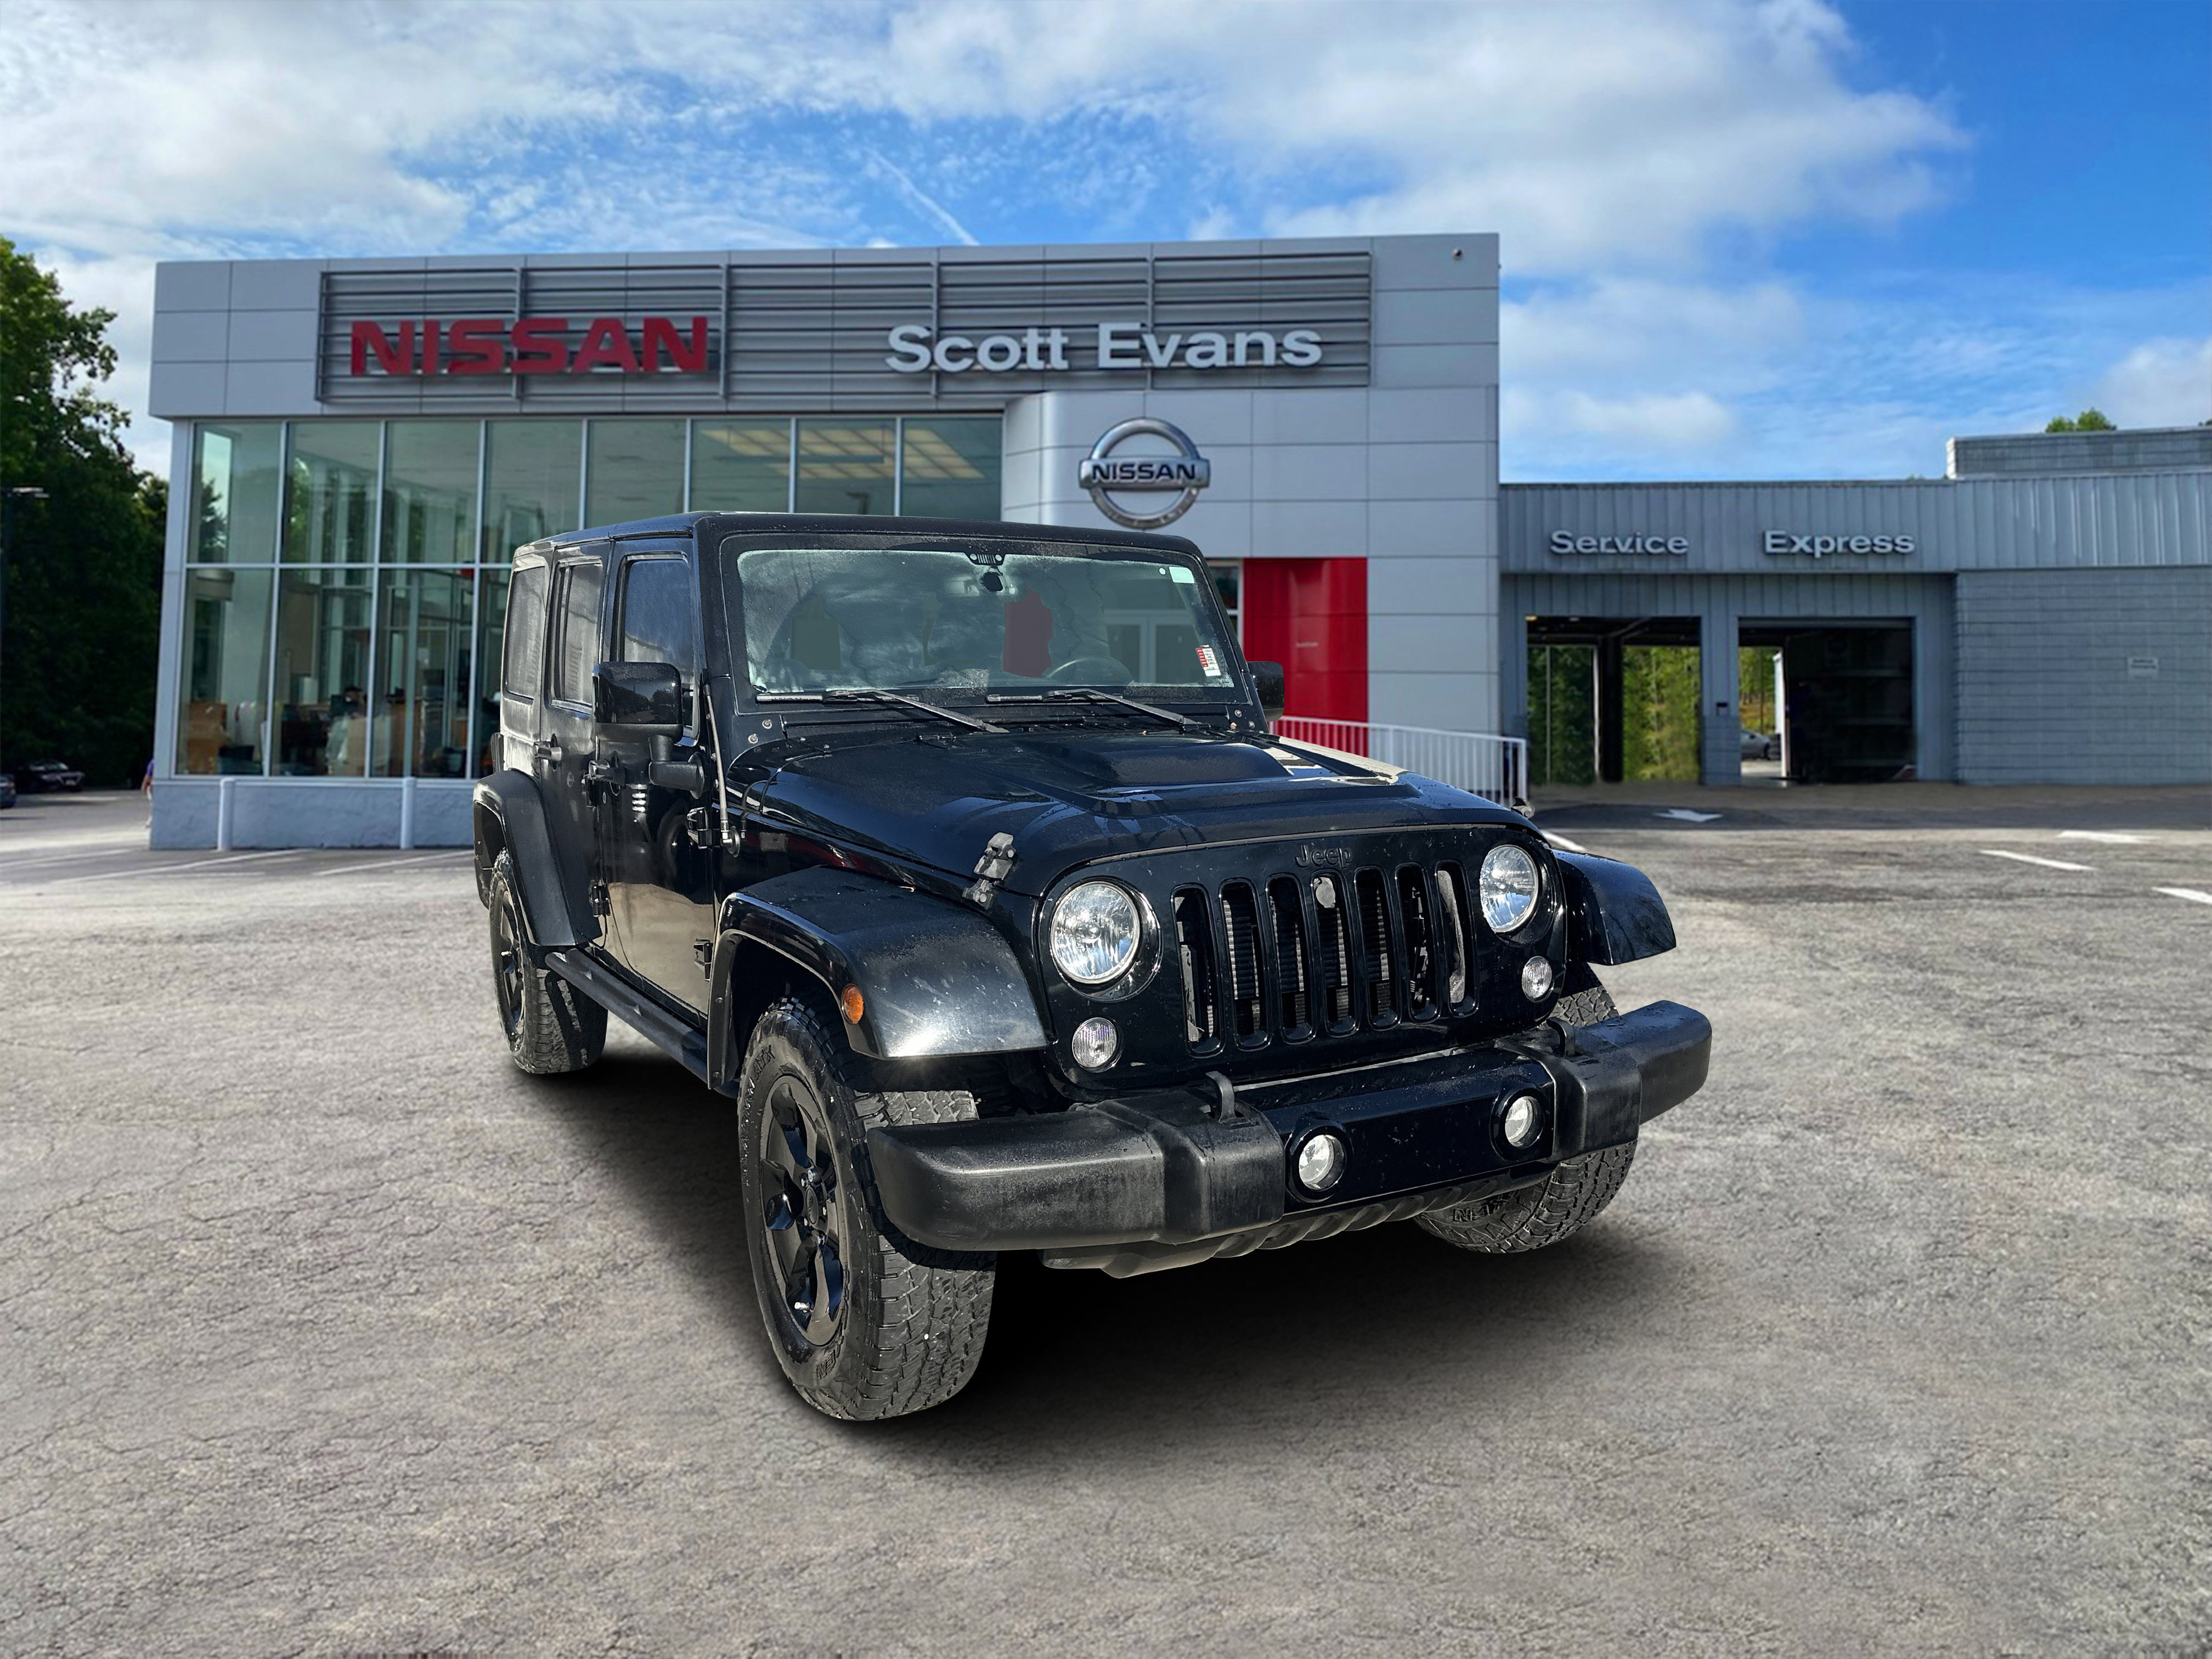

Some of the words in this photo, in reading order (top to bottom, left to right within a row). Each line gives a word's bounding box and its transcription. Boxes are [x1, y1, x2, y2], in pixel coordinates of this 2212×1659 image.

[351, 317, 708, 375] NISSAN
[884, 324, 1070, 373] Scott
[1098, 321, 1323, 370] Evans
[1092, 463, 1195, 481] NISSAN
[1550, 530, 1689, 554] Service
[1764, 530, 1915, 558] Express
[1294, 843, 1353, 869] Jeep
